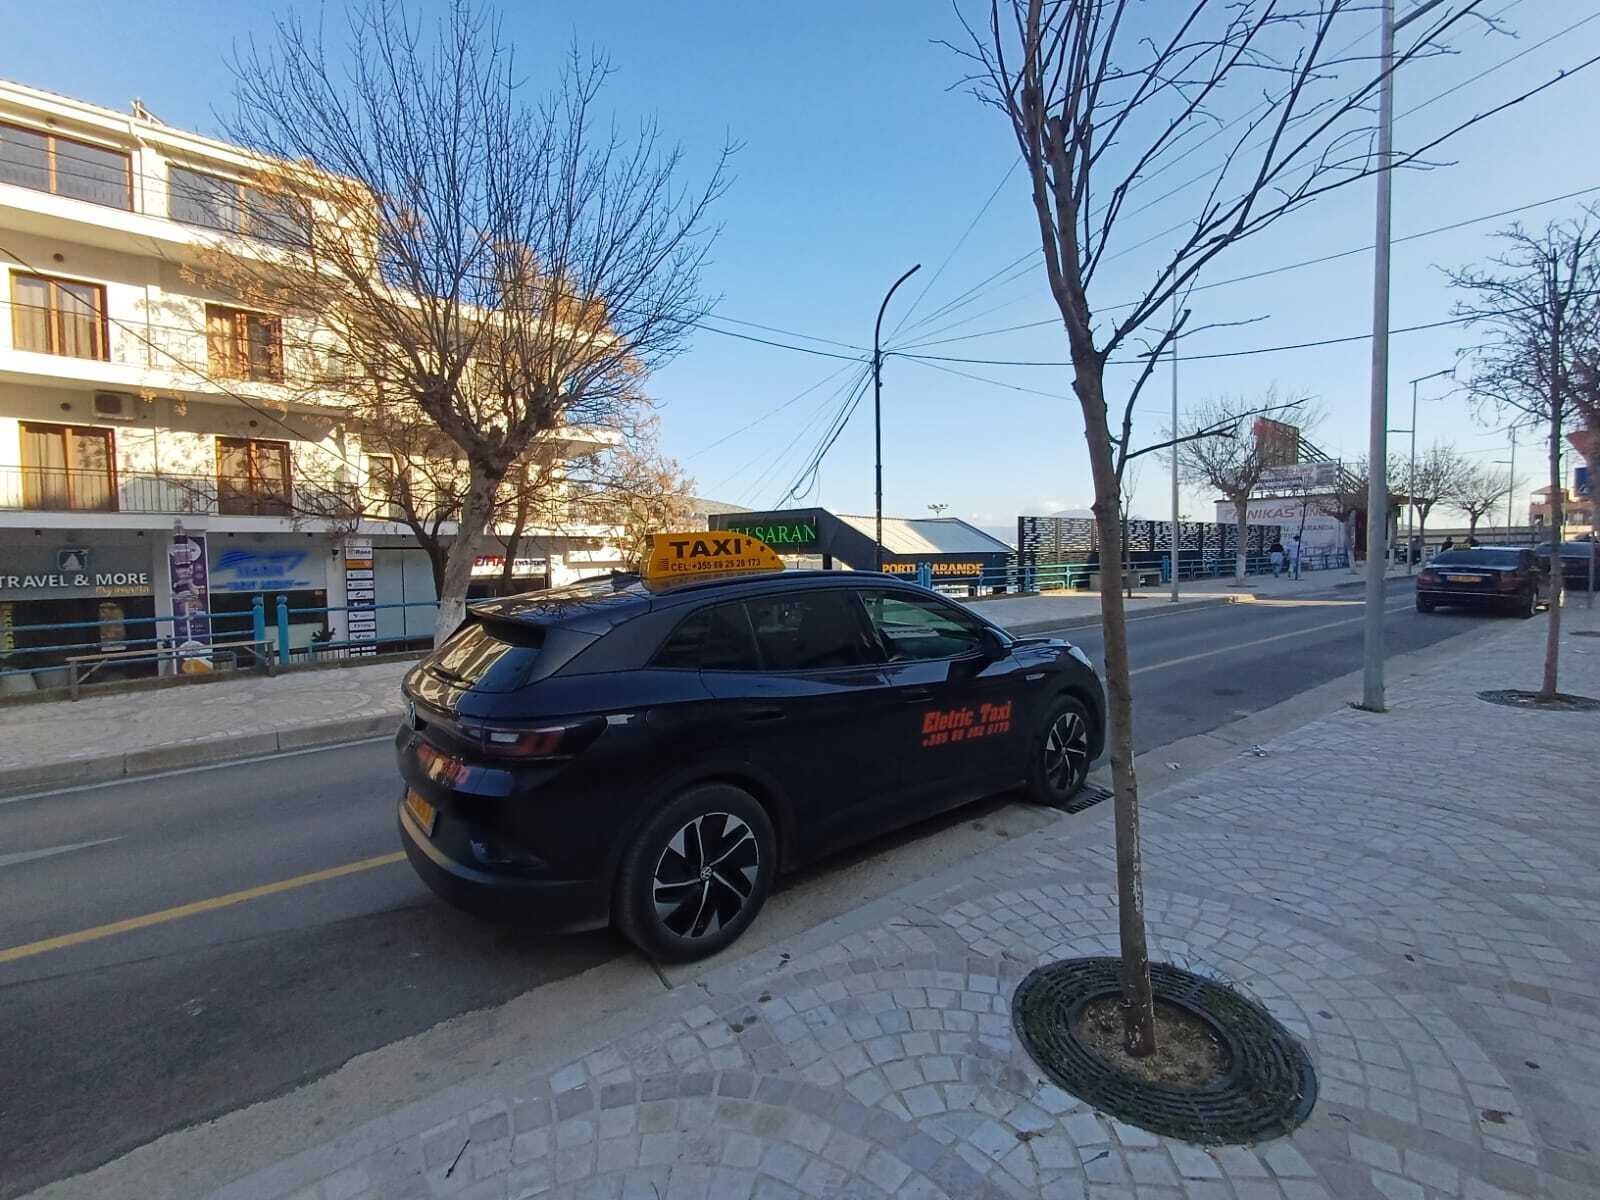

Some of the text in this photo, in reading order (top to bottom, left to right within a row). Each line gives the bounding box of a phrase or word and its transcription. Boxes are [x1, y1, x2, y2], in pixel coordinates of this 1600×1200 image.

[668, 538, 742, 559] TAXI
[882, 562, 984, 575] PORTI ARANDE
[0, 572, 149, 588] TRAVEL & MORE
[980, 700, 1011, 723] Taxi
